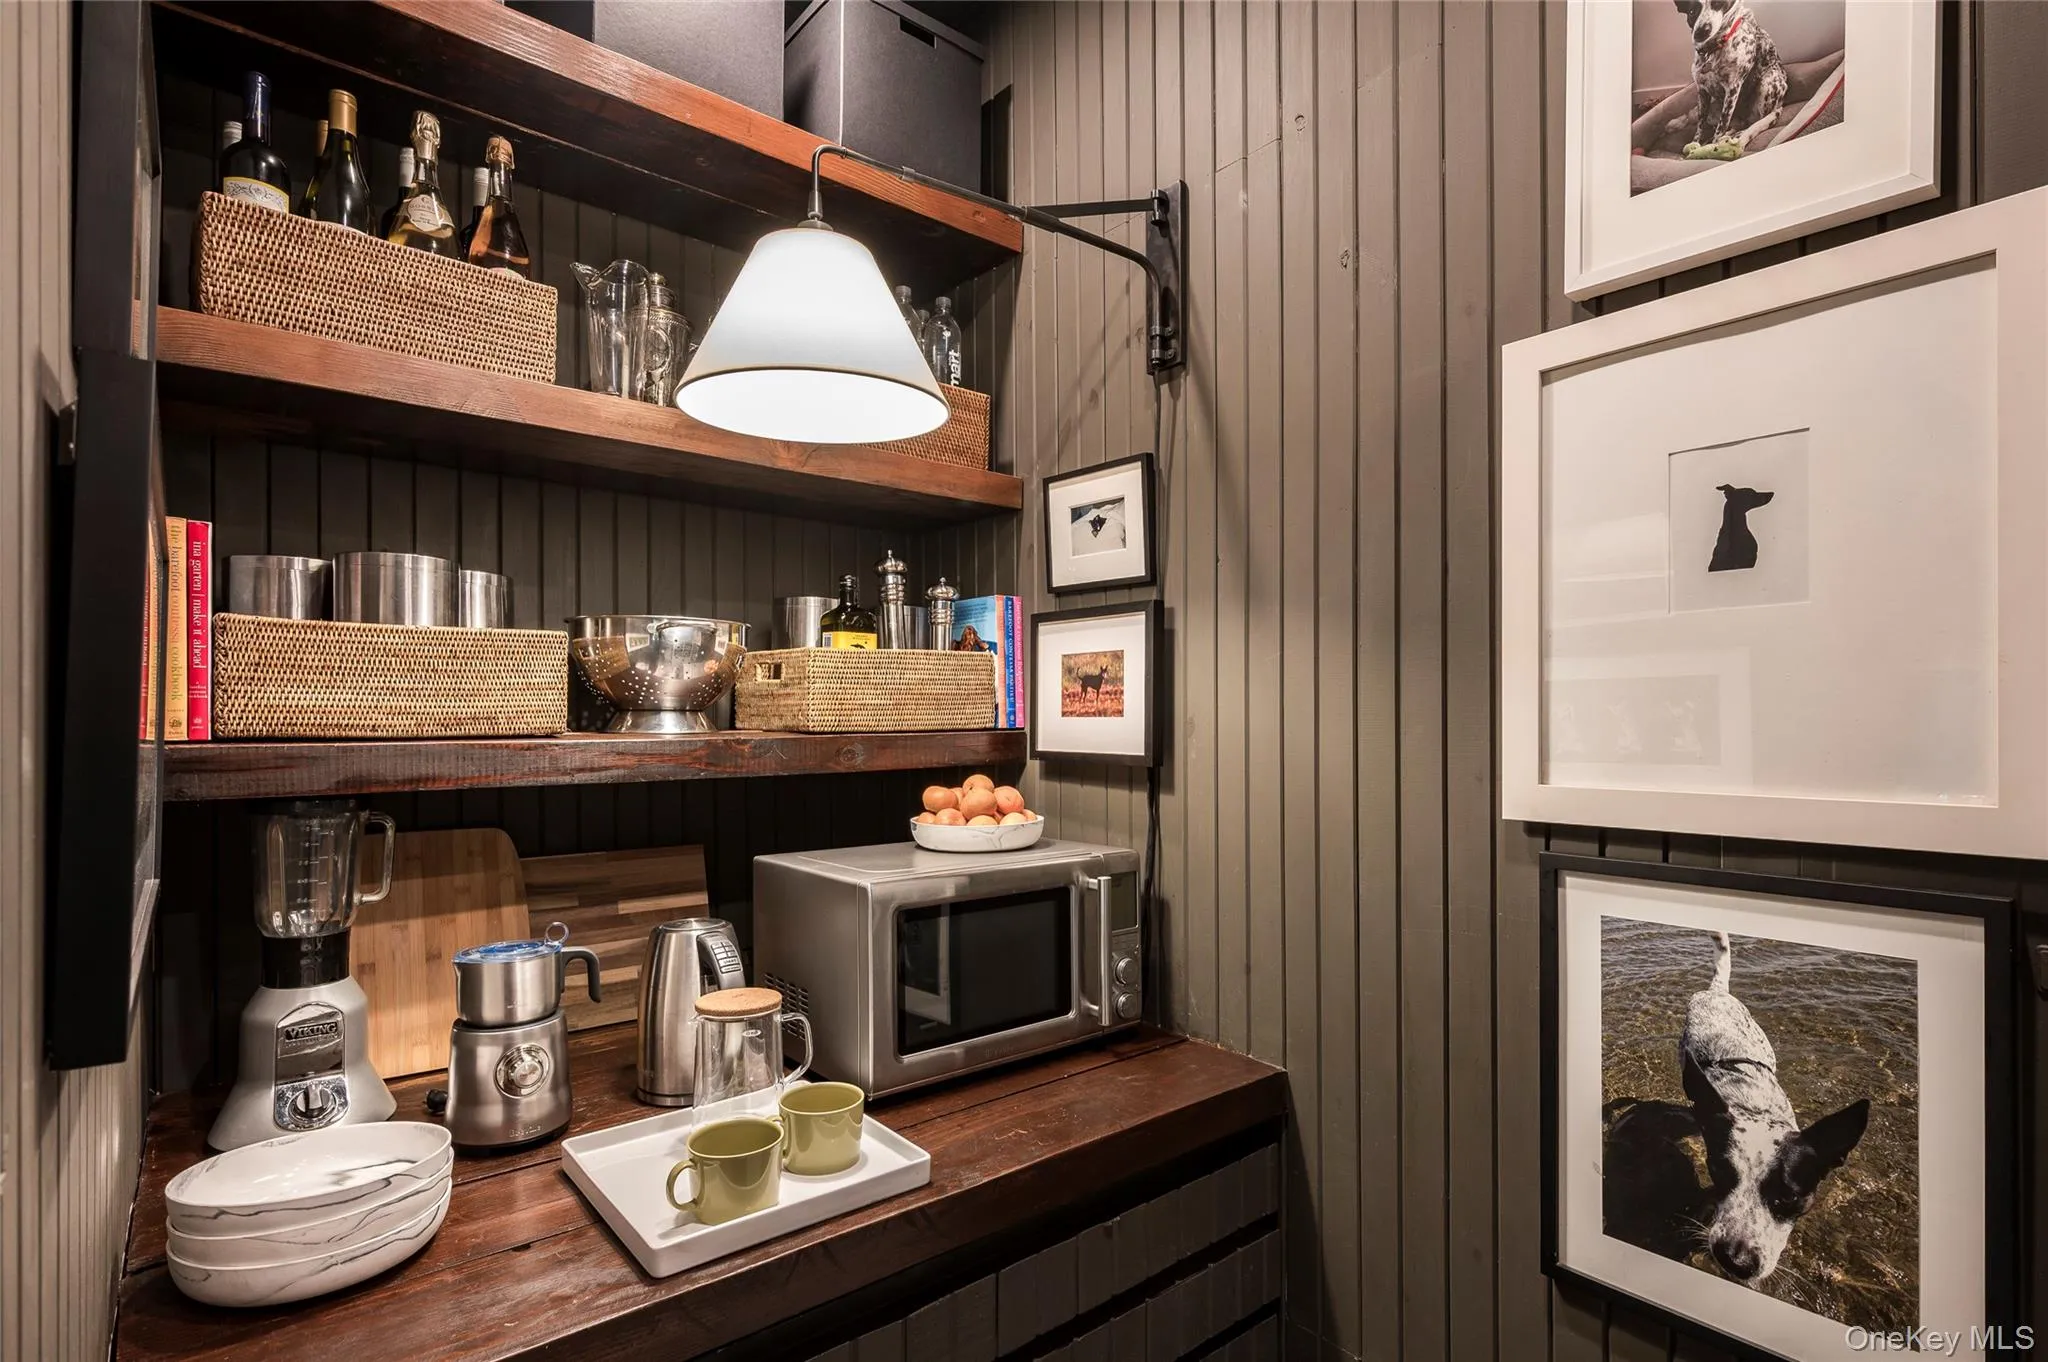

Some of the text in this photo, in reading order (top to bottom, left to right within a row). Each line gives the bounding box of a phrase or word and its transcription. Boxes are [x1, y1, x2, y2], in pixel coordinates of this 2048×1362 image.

[171, 525, 182, 543] the
[193, 541, 206, 557] ina
[171, 546, 182, 592] barefoot
[189, 560, 202, 591] garten
[171, 595, 180, 643] contessa
[193, 600, 207, 626] make
[193, 639, 207, 668] ahead
[171, 646, 182, 700] cookbook
[288, 1022, 337, 1040] VIKING
